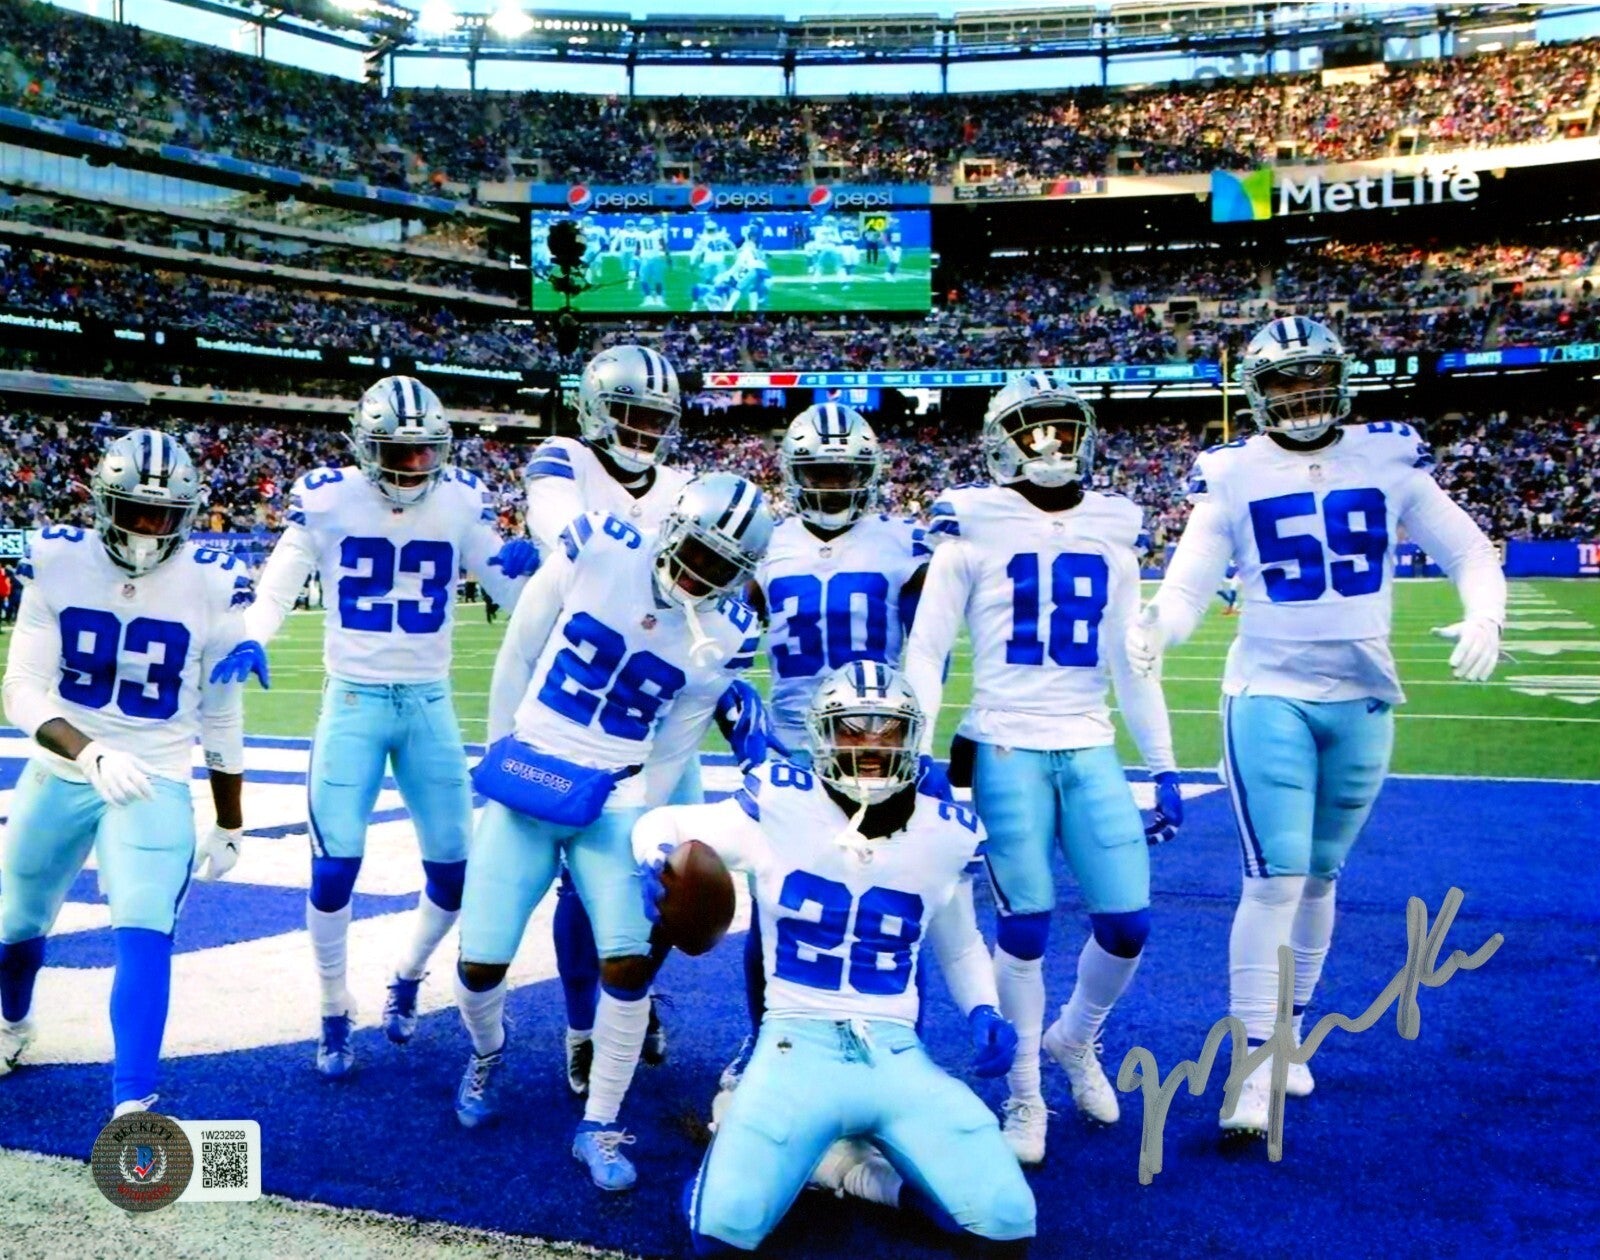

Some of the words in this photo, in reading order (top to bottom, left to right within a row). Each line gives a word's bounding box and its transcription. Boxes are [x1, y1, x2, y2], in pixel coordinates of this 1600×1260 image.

[594, 190, 653, 209] pepsi
[715, 190, 773, 209] pepsi
[834, 190, 893, 209] pepsi
[1279, 166, 1481, 216] MetLife
[1249, 488, 1389, 601] 59
[338, 535, 454, 634] 23
[1005, 552, 1109, 667] 18
[768, 572, 890, 679] 30
[58, 606, 191, 720] 93
[501, 758, 573, 793] COWBOYS
[774, 869, 925, 995] 28
[112, 1121, 175, 1143] BECKETT
[200, 1130, 246, 1140] 1W232929
